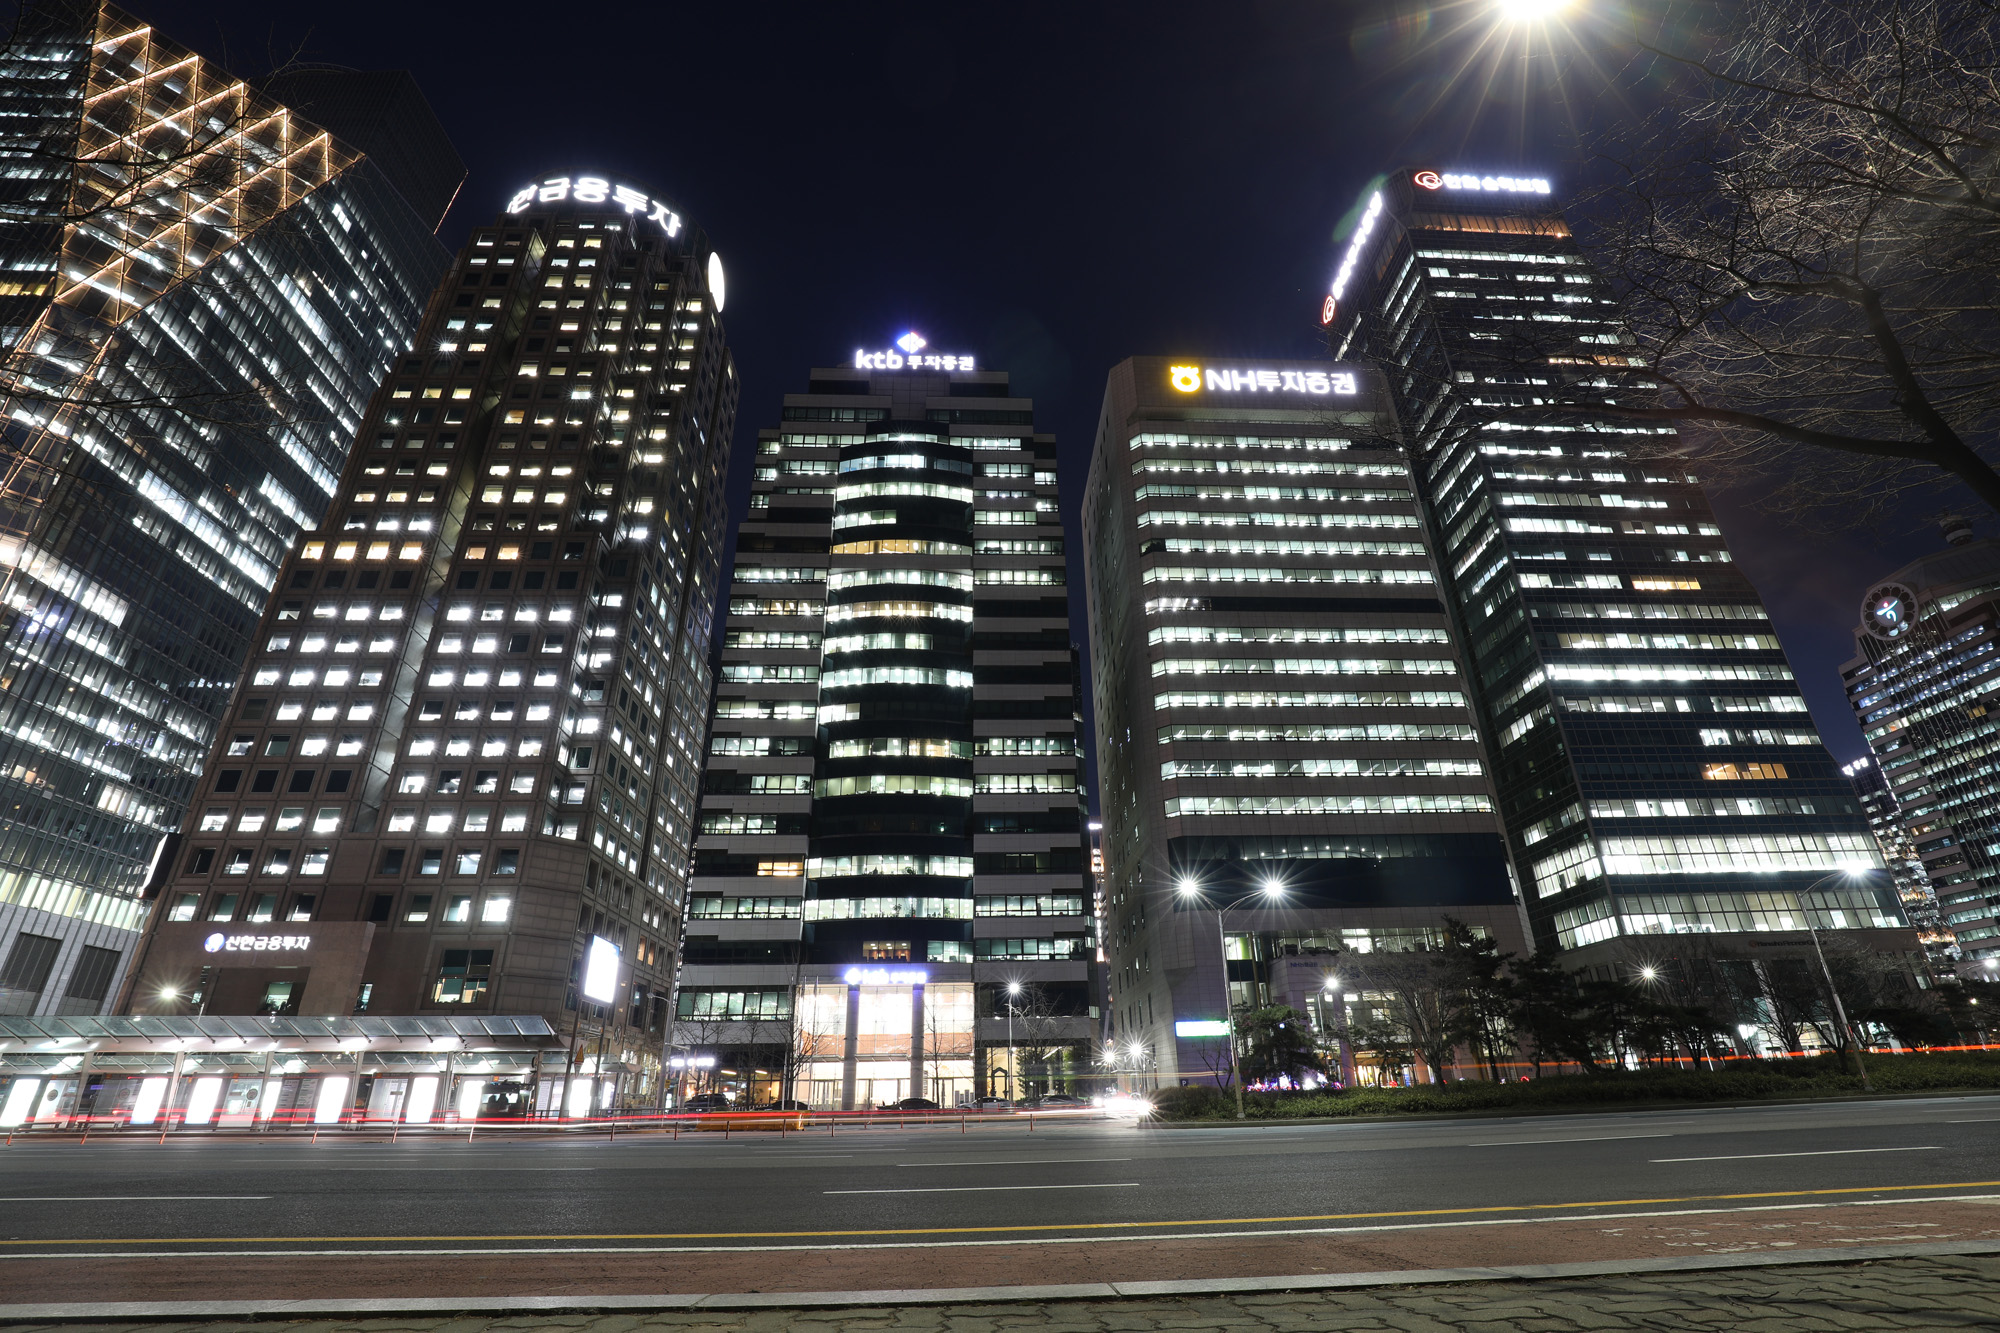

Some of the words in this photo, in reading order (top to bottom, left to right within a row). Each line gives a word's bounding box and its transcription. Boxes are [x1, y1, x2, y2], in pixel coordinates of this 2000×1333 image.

[506, 177, 682, 237] 한금융투자
[855, 348, 903, 369] ktb
[907, 355, 974, 371] 투자증권
[1205, 369, 1357, 394] NH투자증권
[225, 935, 310, 951] 신한금융투자
